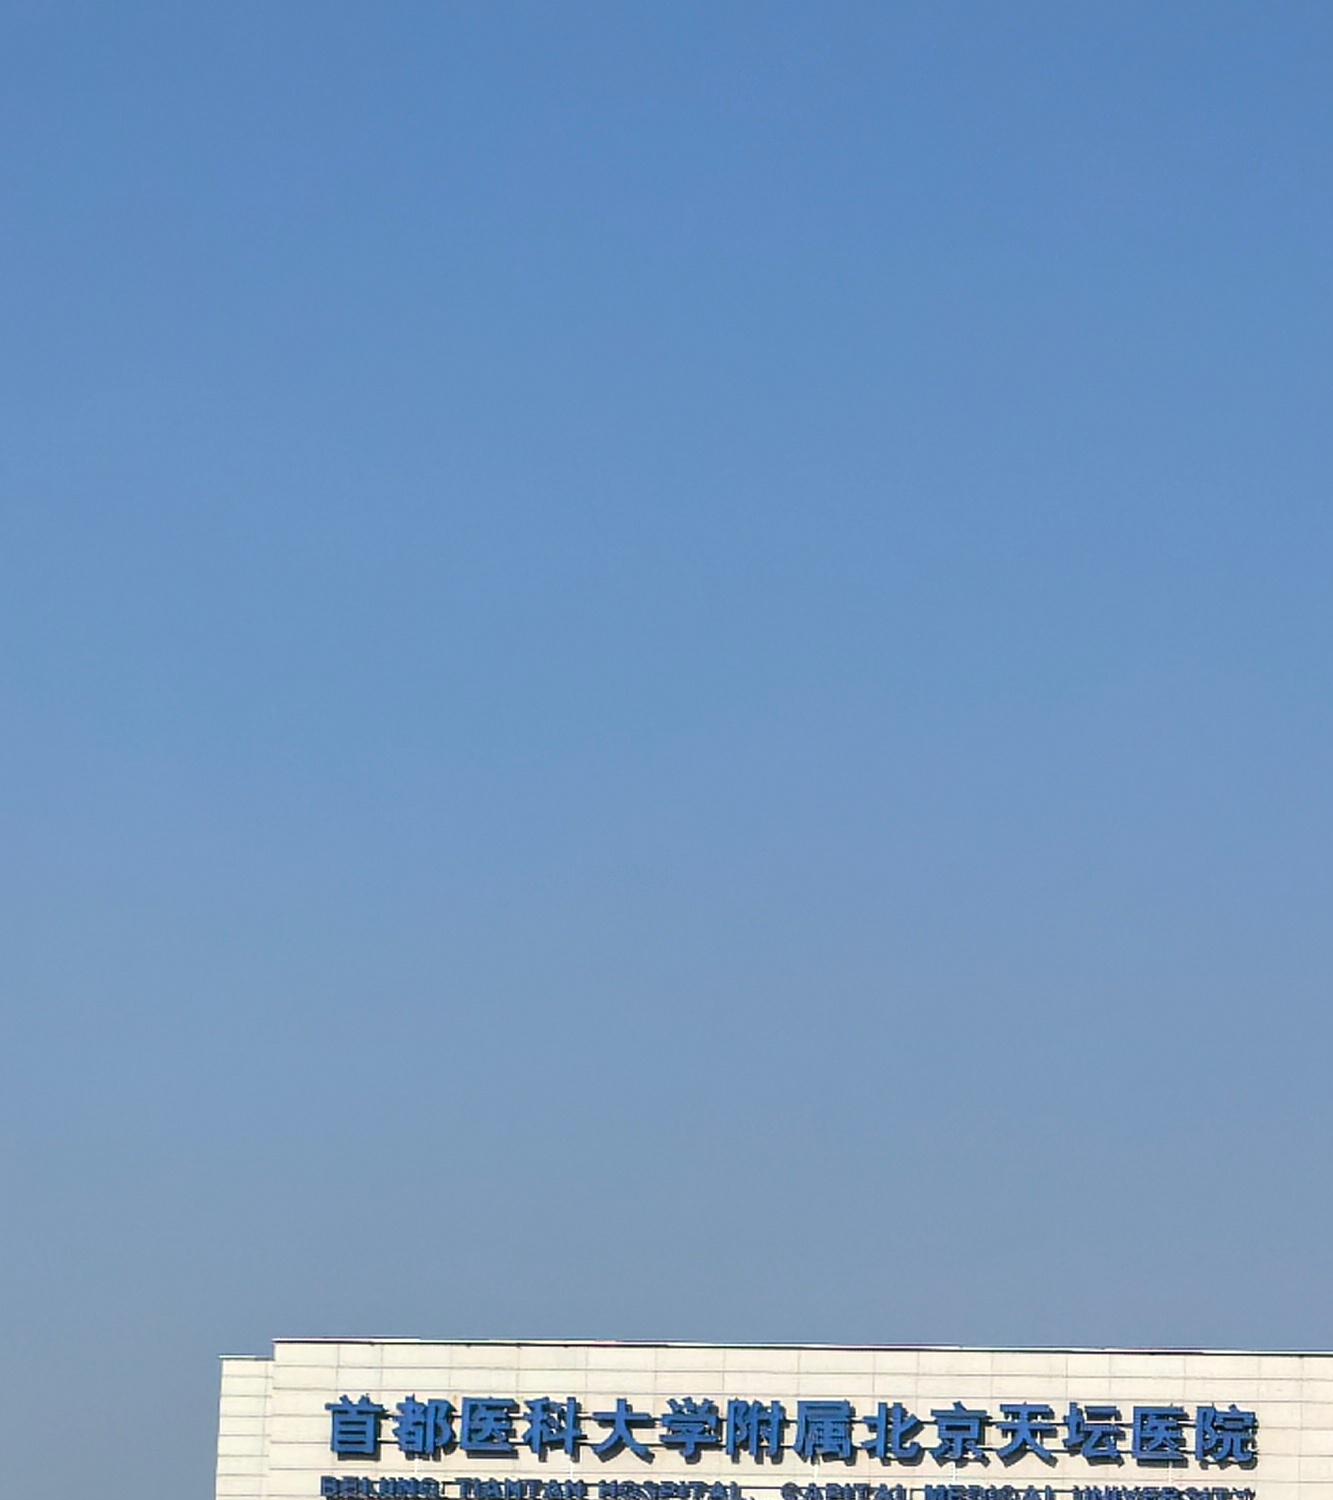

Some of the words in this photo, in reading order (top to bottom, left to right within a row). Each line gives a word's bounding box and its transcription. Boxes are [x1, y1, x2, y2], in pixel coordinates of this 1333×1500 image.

[324, 1396, 1258, 1466] 首都医科大学附属北京天坛医院
